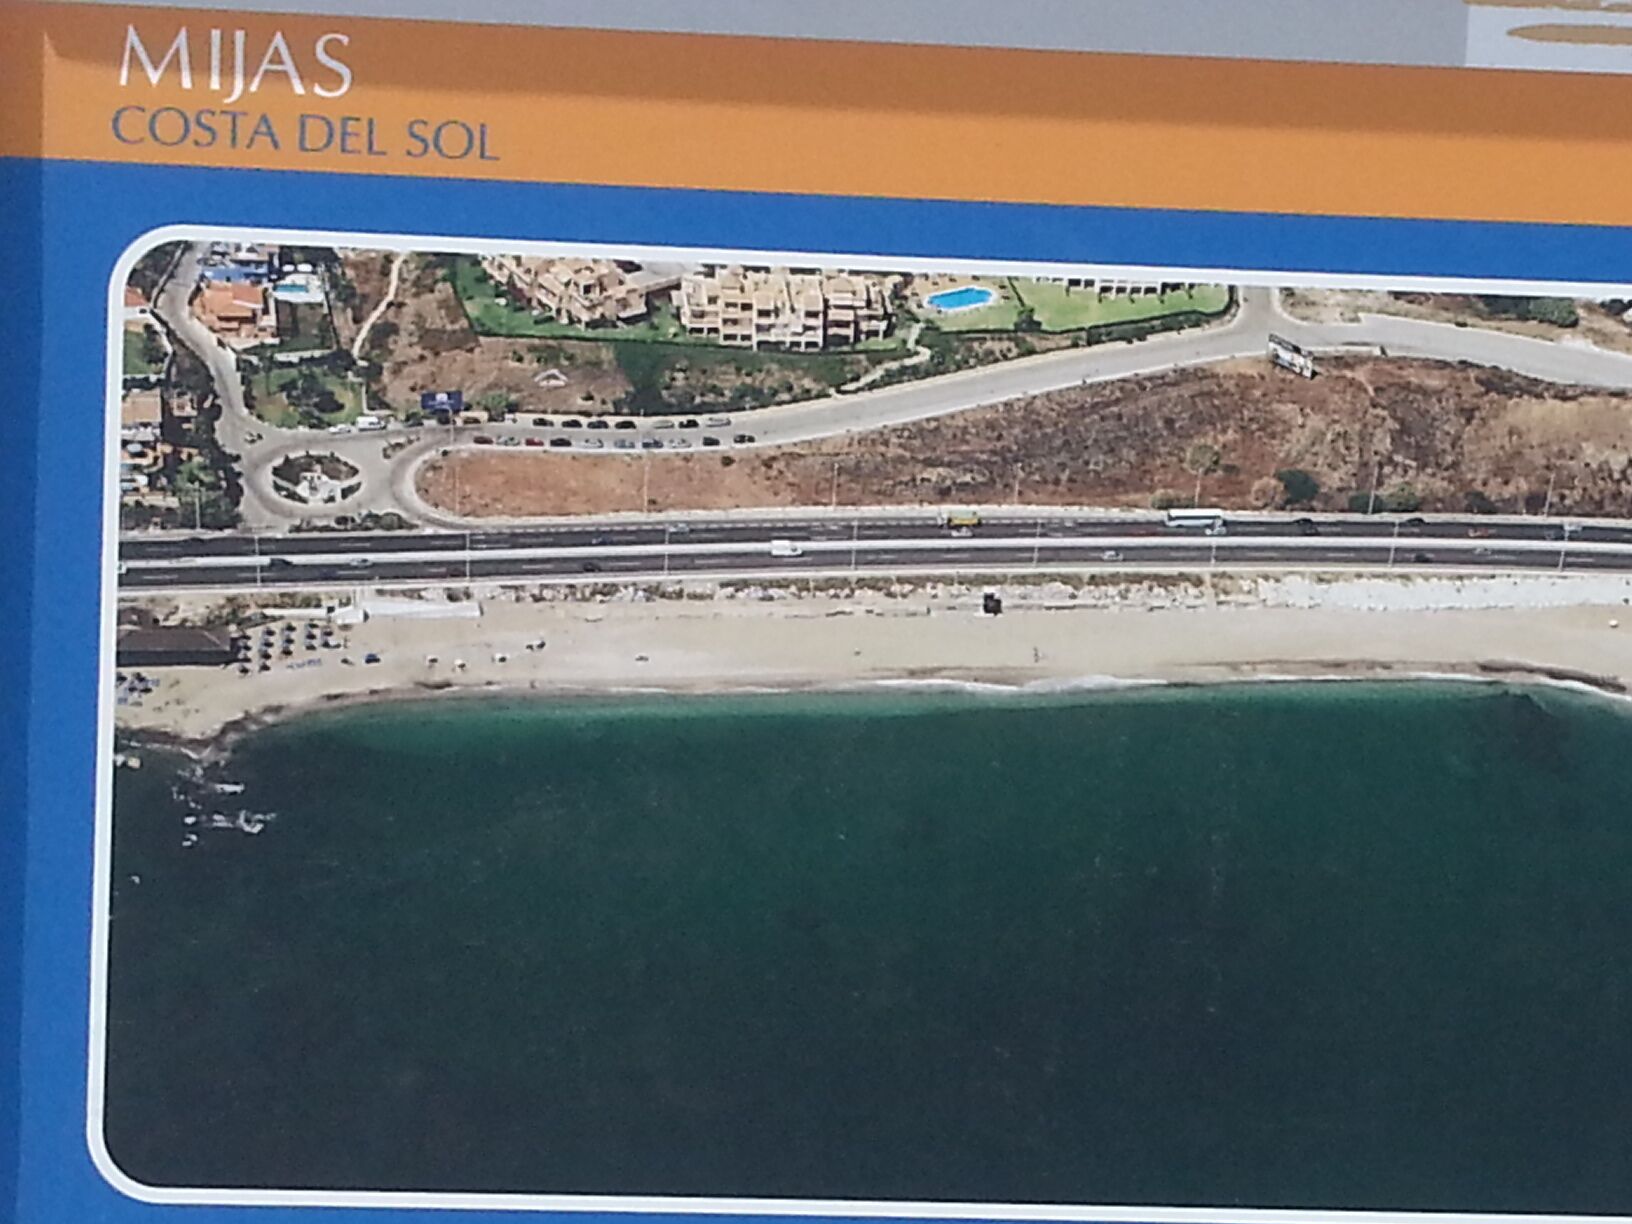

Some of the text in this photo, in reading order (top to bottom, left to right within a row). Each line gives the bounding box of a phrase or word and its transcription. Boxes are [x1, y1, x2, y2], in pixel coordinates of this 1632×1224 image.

[119, 25, 351, 103] MIJAS
[111, 105, 500, 161] COSTA DEL SOL
